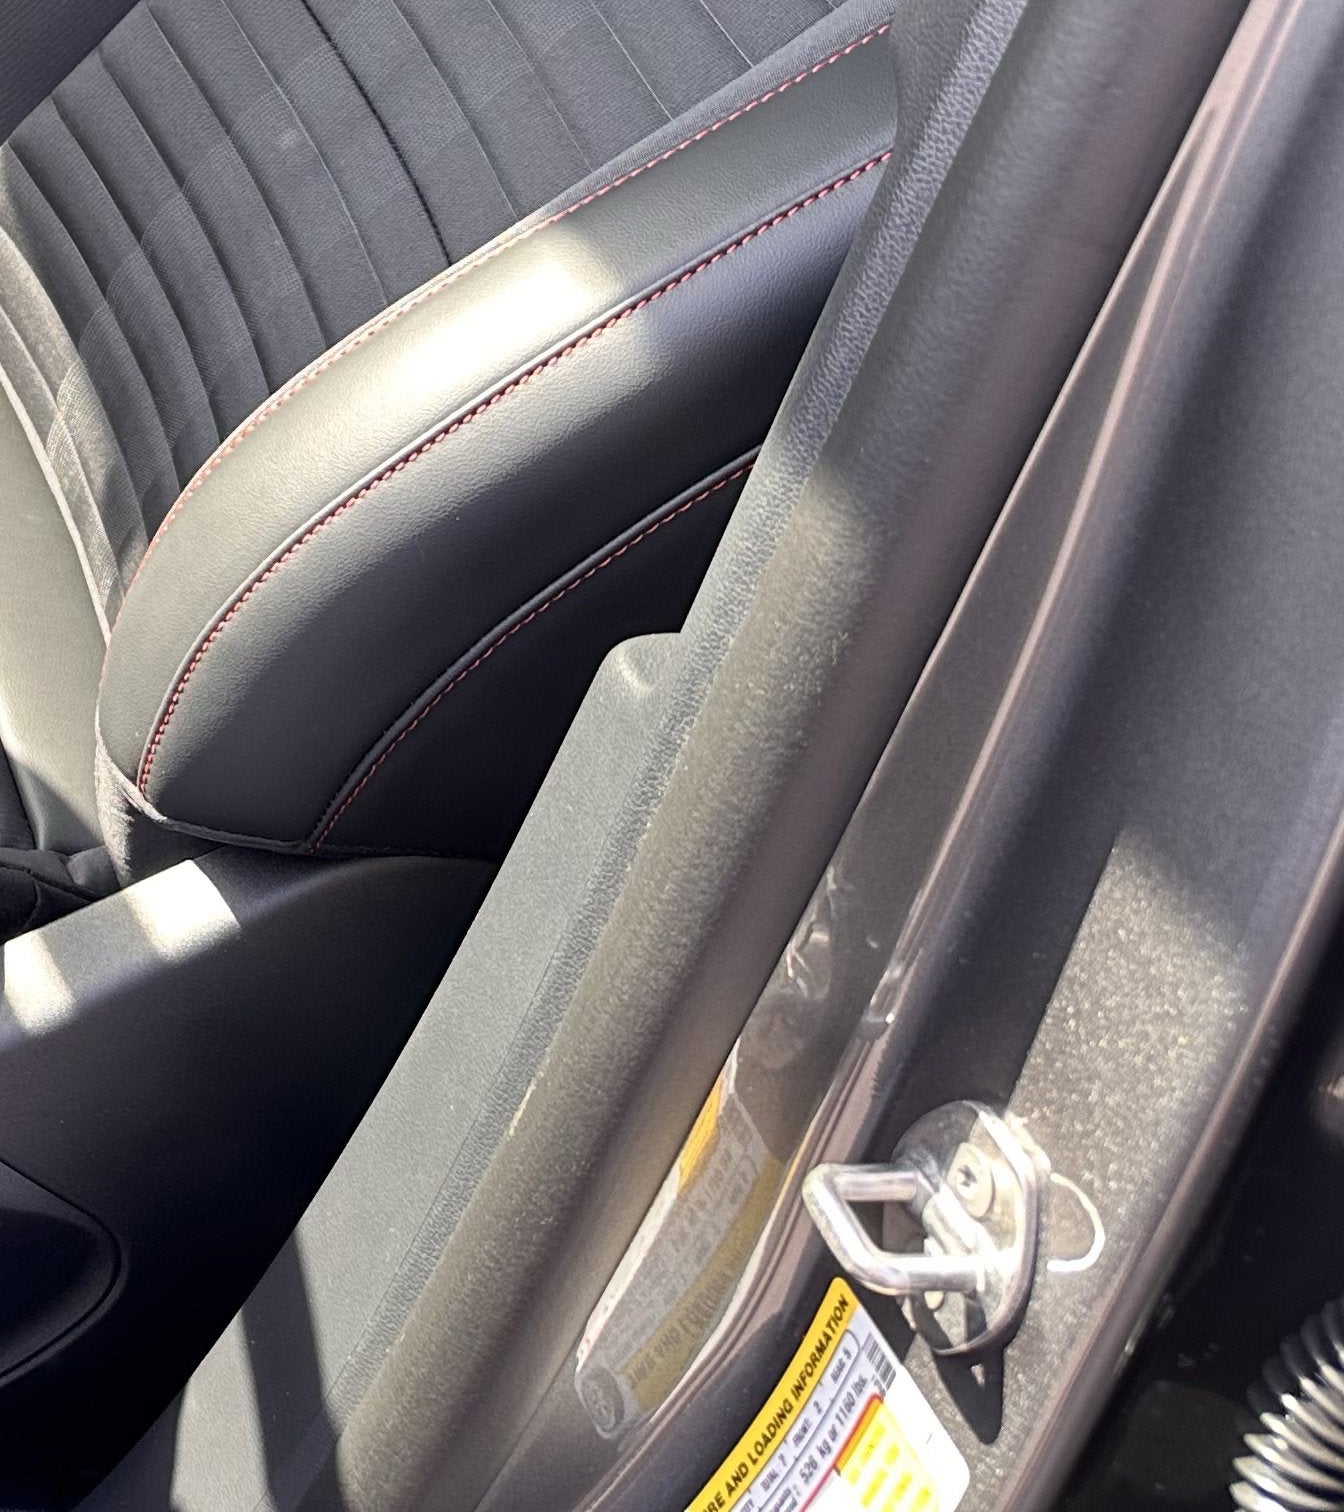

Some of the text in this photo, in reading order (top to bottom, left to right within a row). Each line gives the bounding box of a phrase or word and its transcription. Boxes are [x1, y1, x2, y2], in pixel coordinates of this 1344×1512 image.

[725, 1461, 749, 1498] AND
[747, 1398, 794, 1466] LOADING
[790, 1293, 850, 1402] INFORMATION
[816, 1438, 832, 1459] kg
